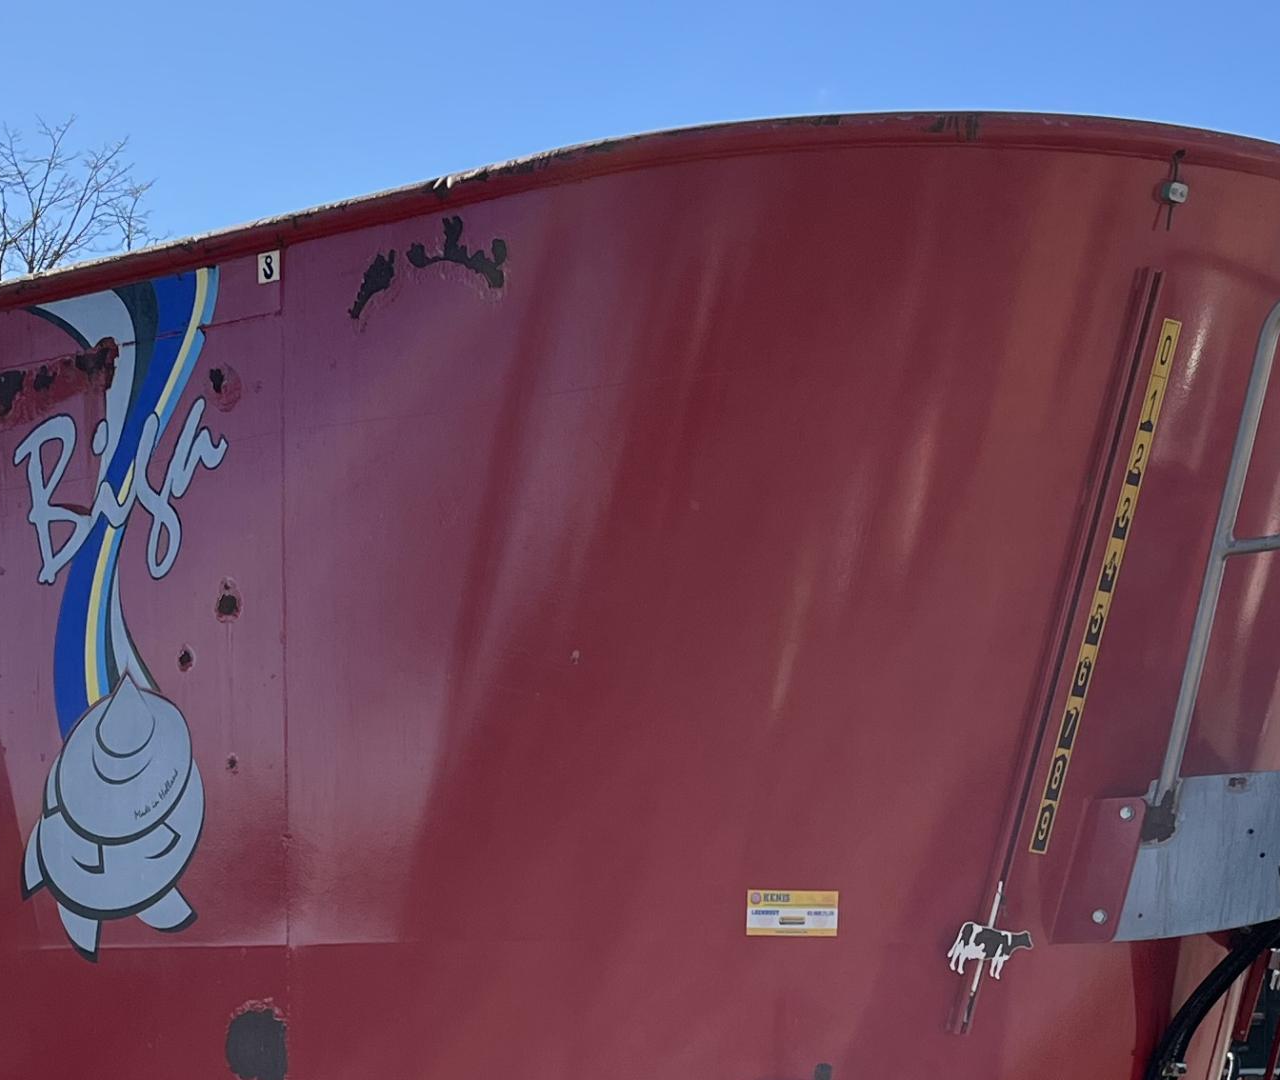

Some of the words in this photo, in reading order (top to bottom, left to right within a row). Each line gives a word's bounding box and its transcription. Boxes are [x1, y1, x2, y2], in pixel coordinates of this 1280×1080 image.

[1160, 335, 1172, 365] 0
[1148, 390, 1158, 422] 1
[1131, 444, 1144, 474] 2
[1064, 706, 1078, 737] 7
[1051, 760, 1063, 790] 8
[1038, 811, 1050, 841] 9
